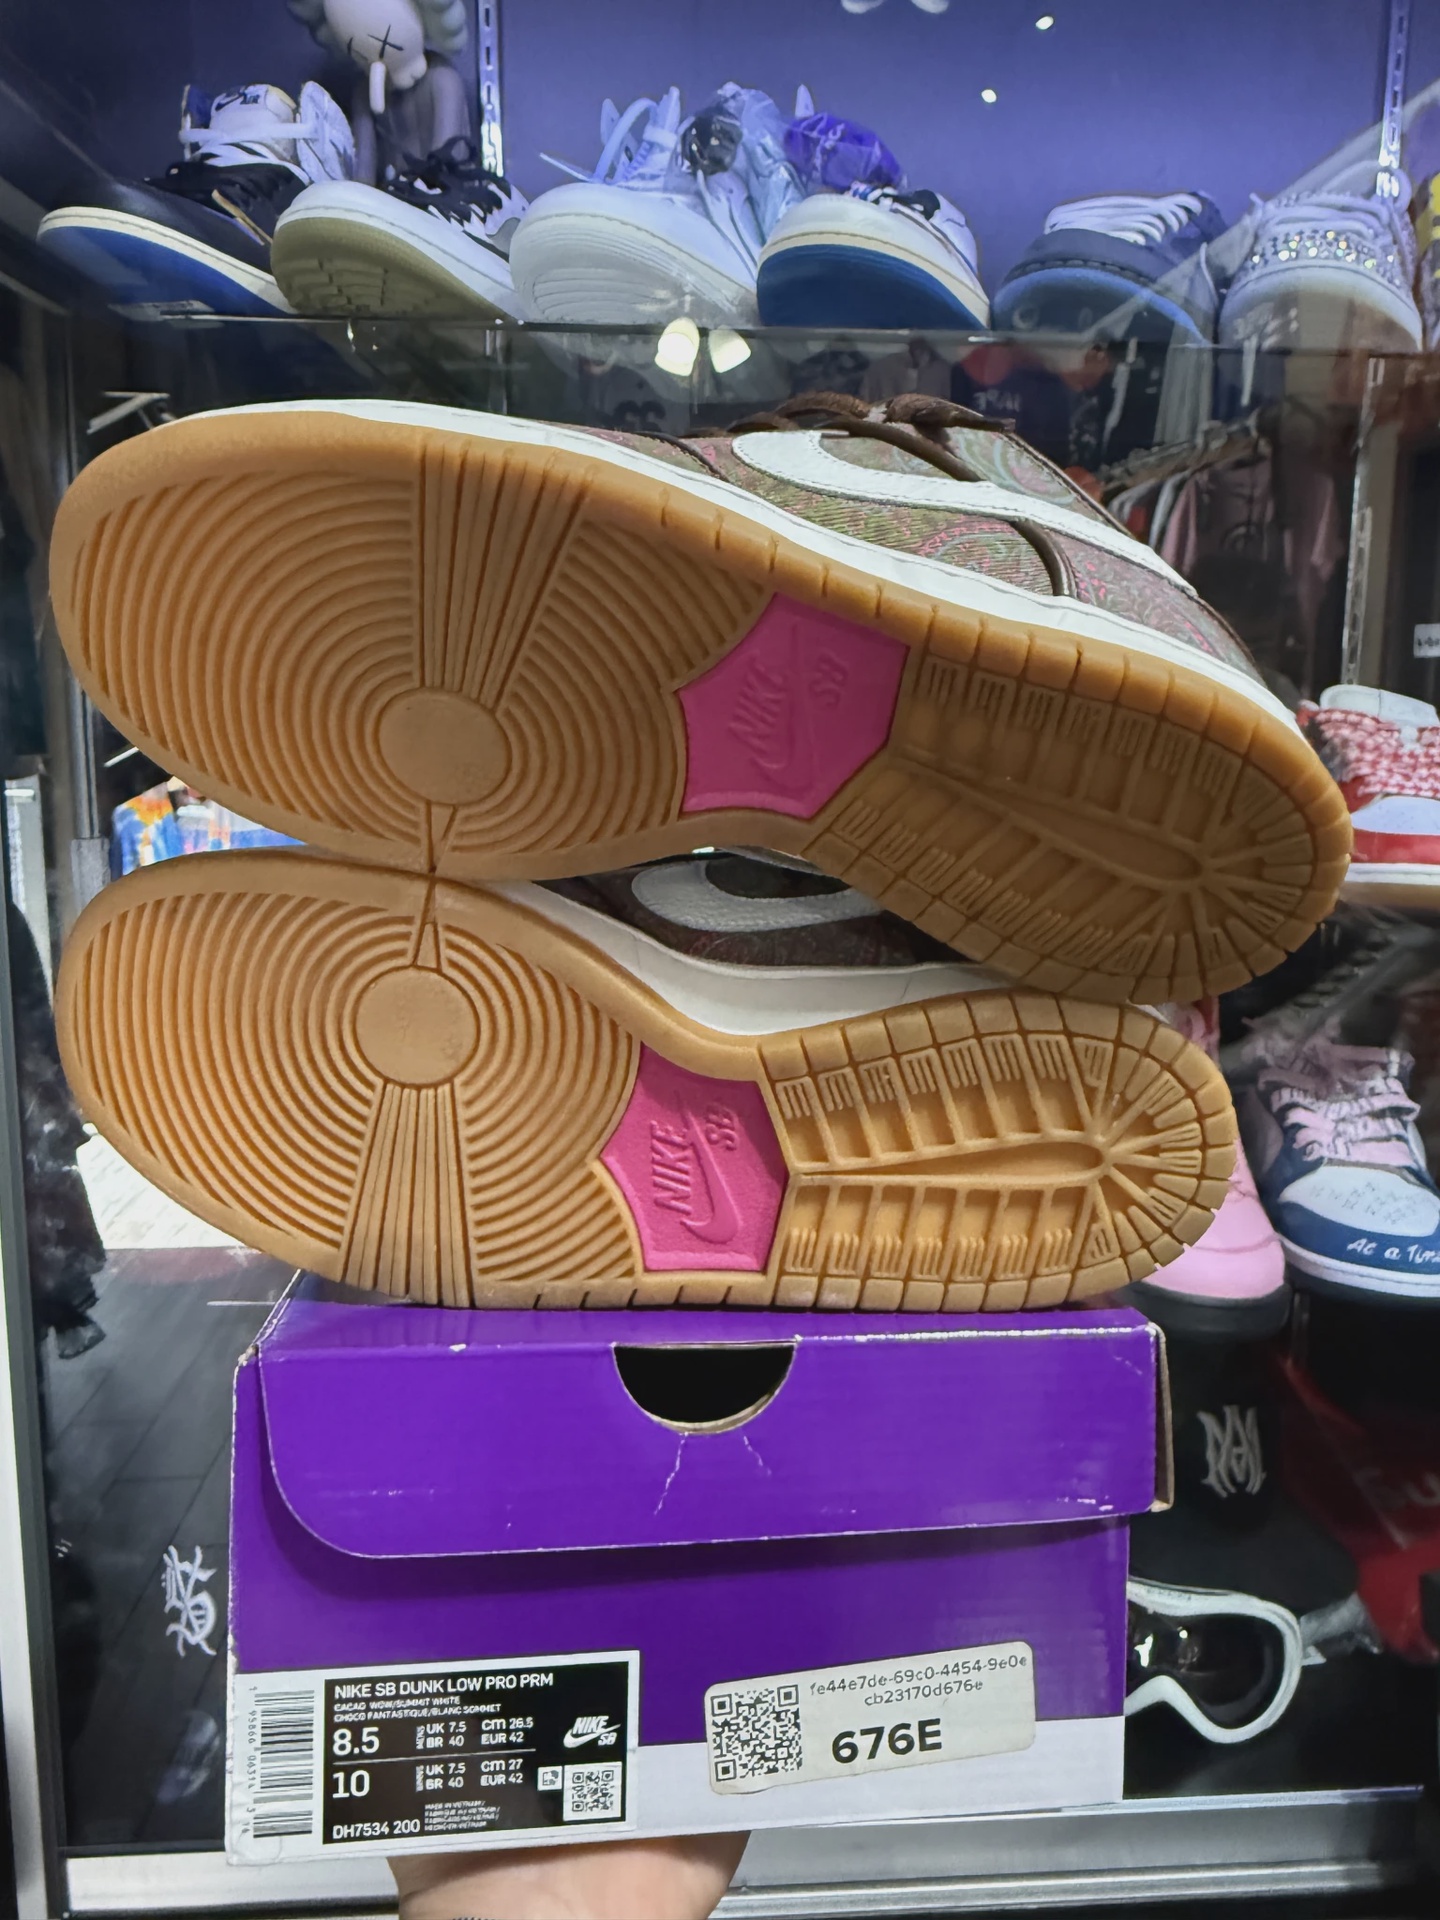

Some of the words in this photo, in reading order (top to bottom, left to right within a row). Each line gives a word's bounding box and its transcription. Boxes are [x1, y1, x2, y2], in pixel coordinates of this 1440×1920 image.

[704, 1100, 739, 1152] SB
[649, 1119, 692, 1216] NIKE
[334, 1682, 372, 1699] NIKE
[375, 1681, 397, 1696] SB
[399, 1679, 445, 1695] DUNK
[447, 1676, 483, 1692] LOW
[485, 1674, 517, 1690] PRO
[520, 1672, 554, 1688] PRM
[426, 1723, 445, 1734] UK
[449, 1721, 467, 1733] 7.5
[481, 1718, 506, 1731] cm
[508, 1717, 534, 1730] 26.5
[572, 1715, 609, 1735] NIKE
[332, 1726, 380, 1756] 8.5
[449, 1735, 465, 1747] 40
[481, 1732, 507, 1745] EUR
[509, 1731, 524, 1743] 42
[597, 1731, 617, 1746] SB
[831, 1717, 943, 1764] 676E
[425, 1764, 444, 1776] UK
[448, 1762, 466, 1774] 7.5
[480, 1760, 505, 1773] cm
[508, 1759, 524, 1771] 27
[332, 1769, 371, 1799] 10
[448, 1776, 464, 1788] 40
[480, 1774, 506, 1787] EUR
[508, 1772, 524, 1784] 42
[332, 1821, 390, 1840] DH7534
[392, 1818, 421, 1836] 200
